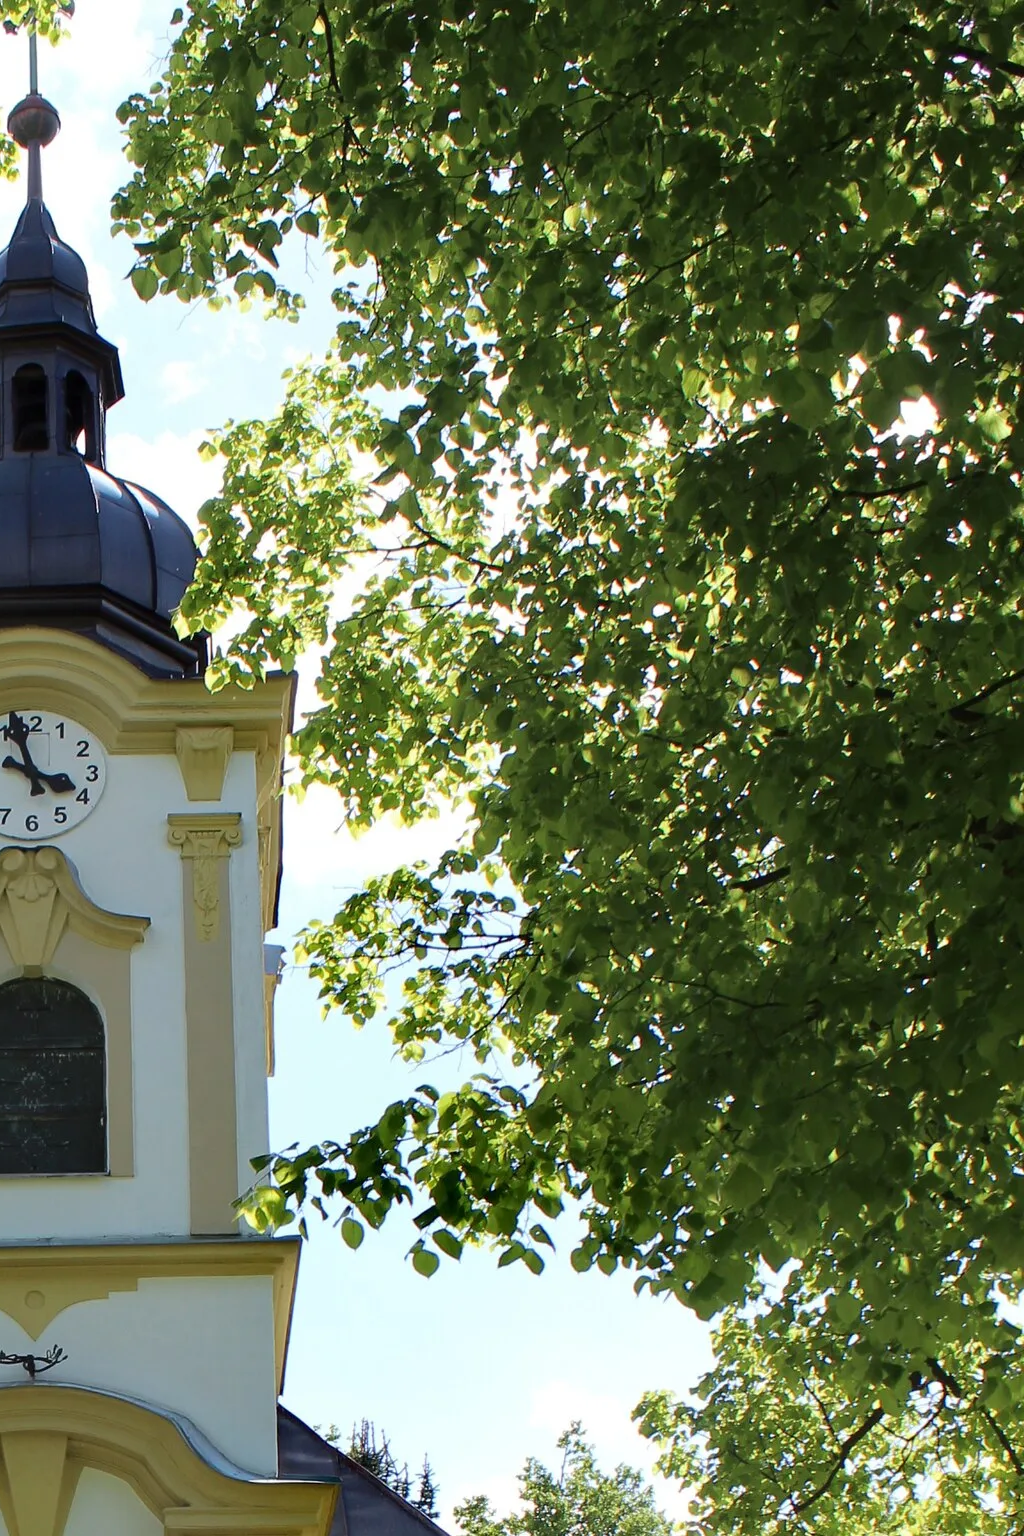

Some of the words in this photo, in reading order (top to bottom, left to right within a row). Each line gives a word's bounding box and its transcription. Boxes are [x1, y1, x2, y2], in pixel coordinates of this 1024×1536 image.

[56, 722, 64, 739] 1
[77, 741, 89, 757] 2
[86, 765, 98, 782] 3
[76, 788, 90, 804] 4
[0, 808, 12, 825] 7
[26, 815, 38, 831] 6
[54, 807, 67, 823] 5
